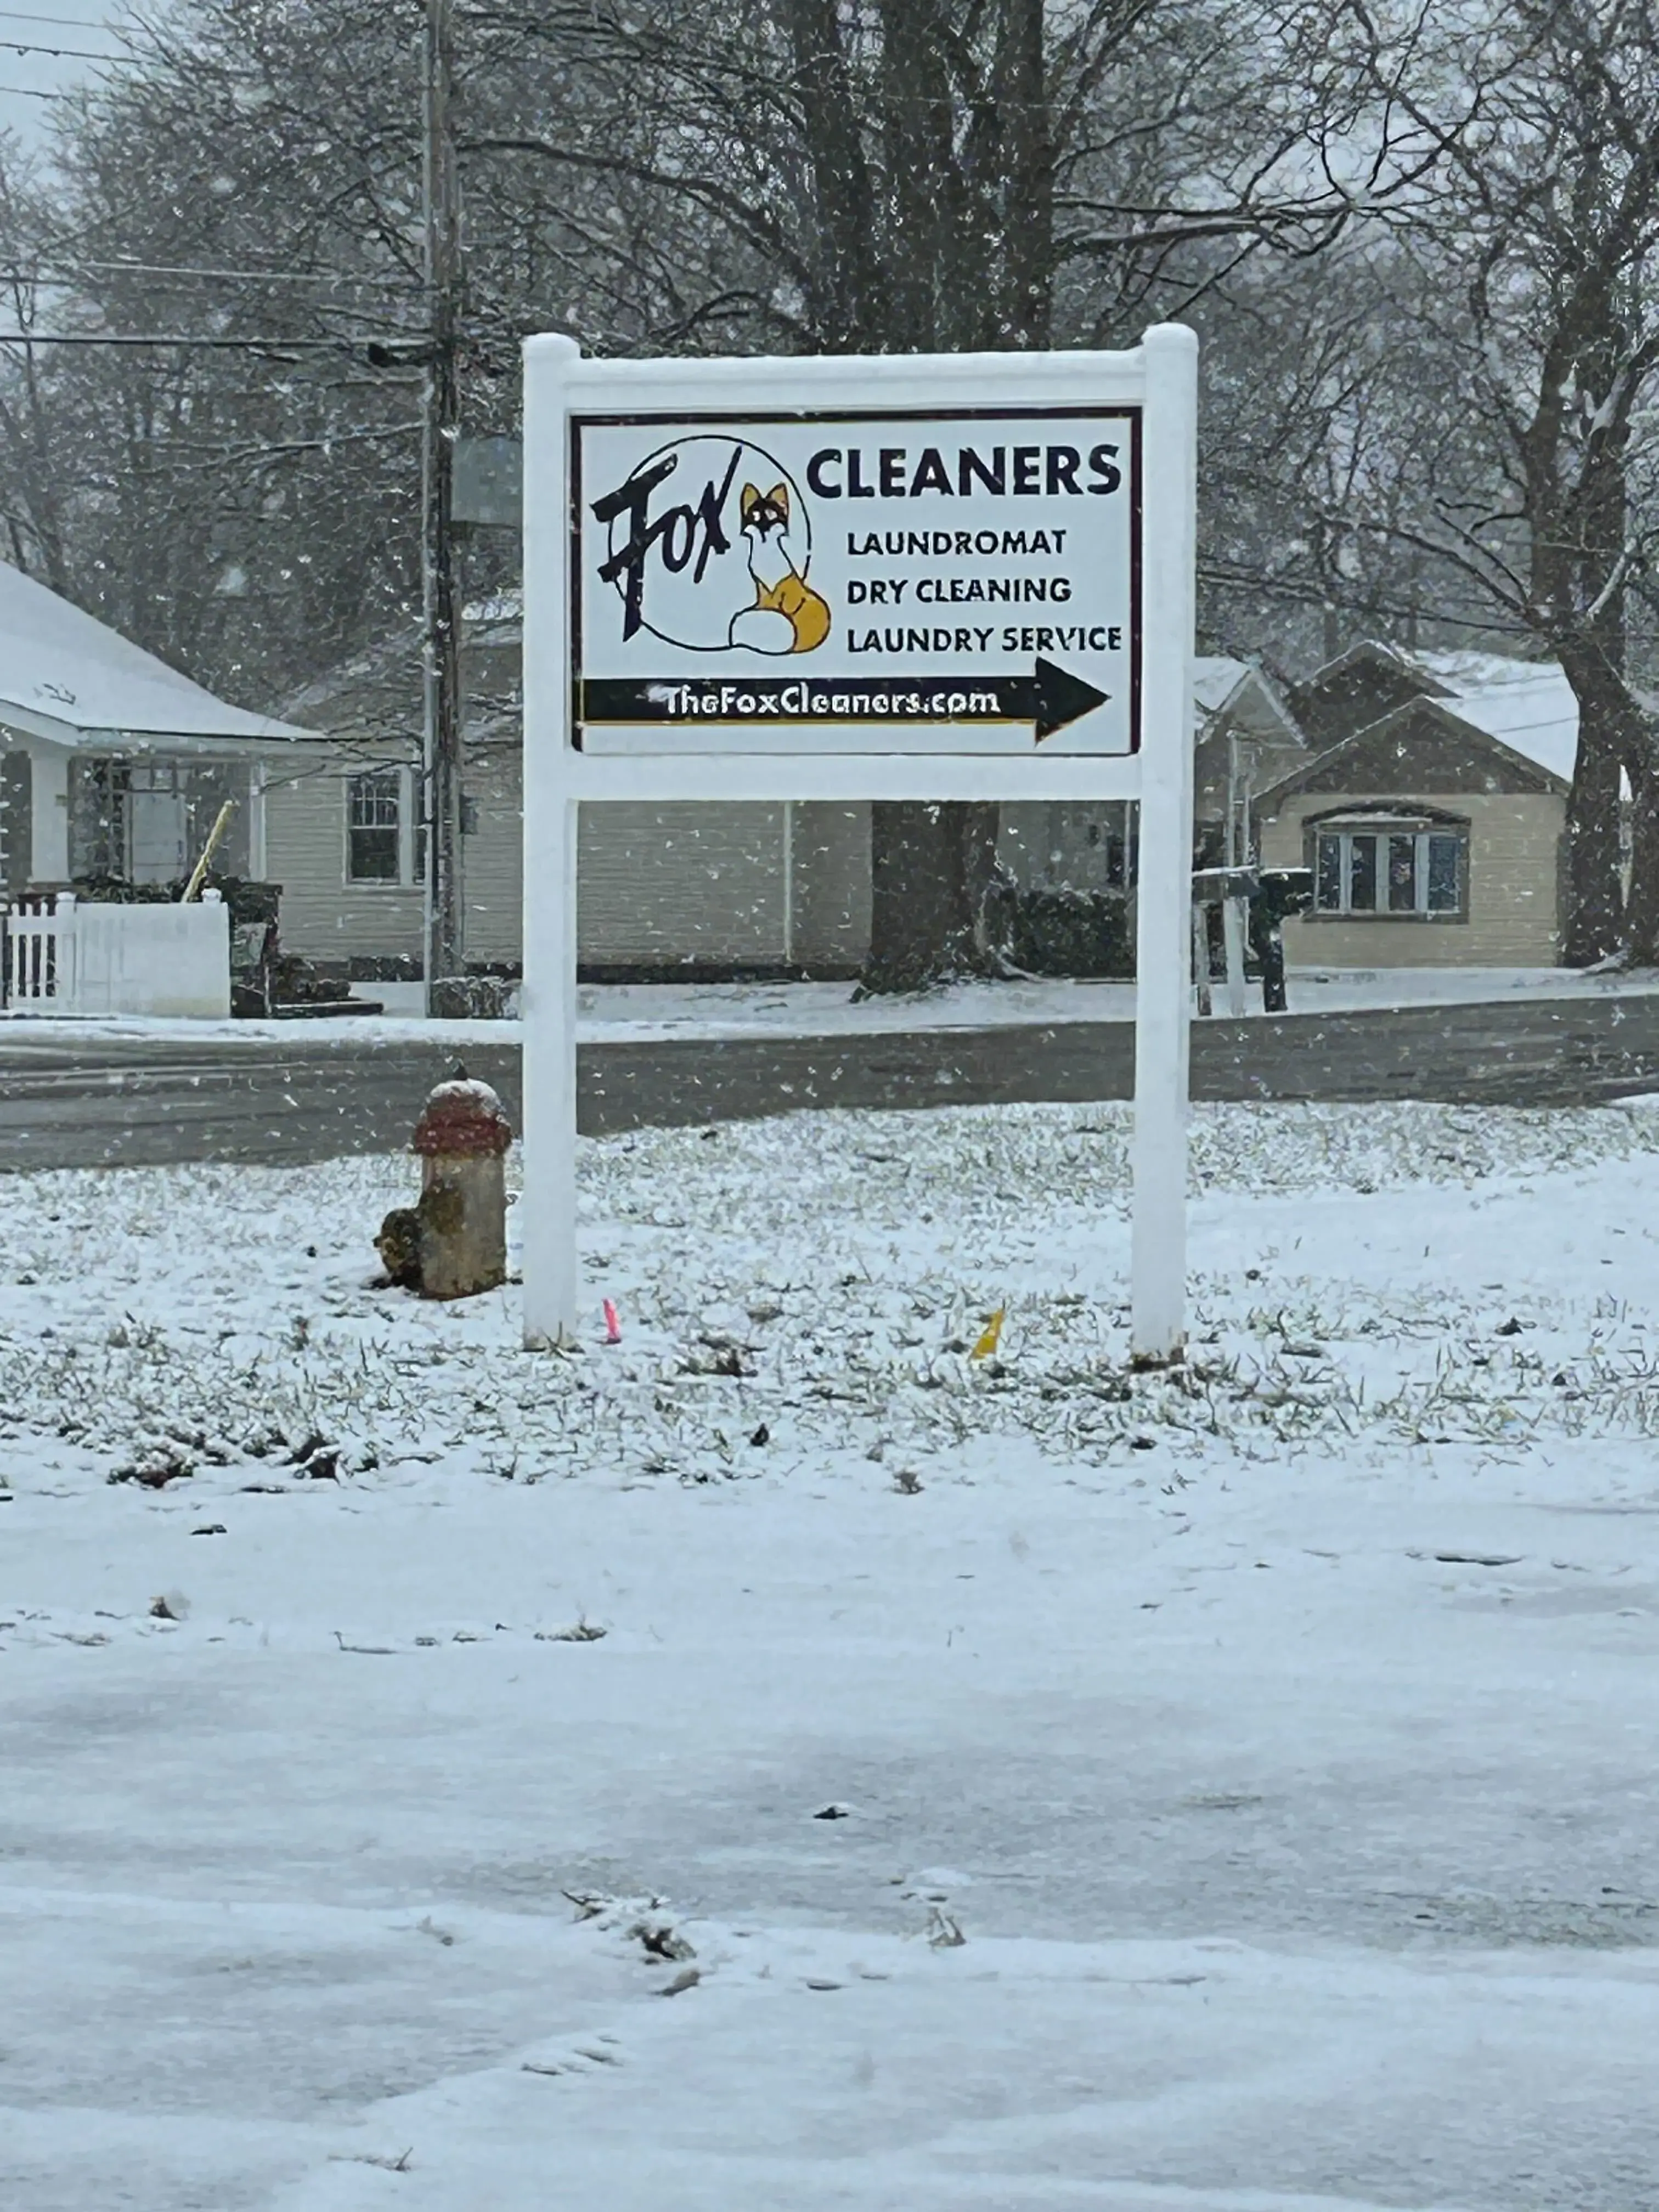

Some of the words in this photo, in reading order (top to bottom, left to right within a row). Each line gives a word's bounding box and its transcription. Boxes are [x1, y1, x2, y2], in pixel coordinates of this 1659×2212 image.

[806, 444, 1121, 499] CLEANERS
[589, 445, 742, 642] Fox
[847, 529, 1066, 556] LAUNDROMAT
[847, 579, 909, 605] DRY
[915, 577, 1073, 603] CLEANING
[847, 627, 995, 653] LAUNDRY
[1001, 627, 1122, 652] SERVICE
[661, 682, 1002, 715] TheFoxCleaners.com
